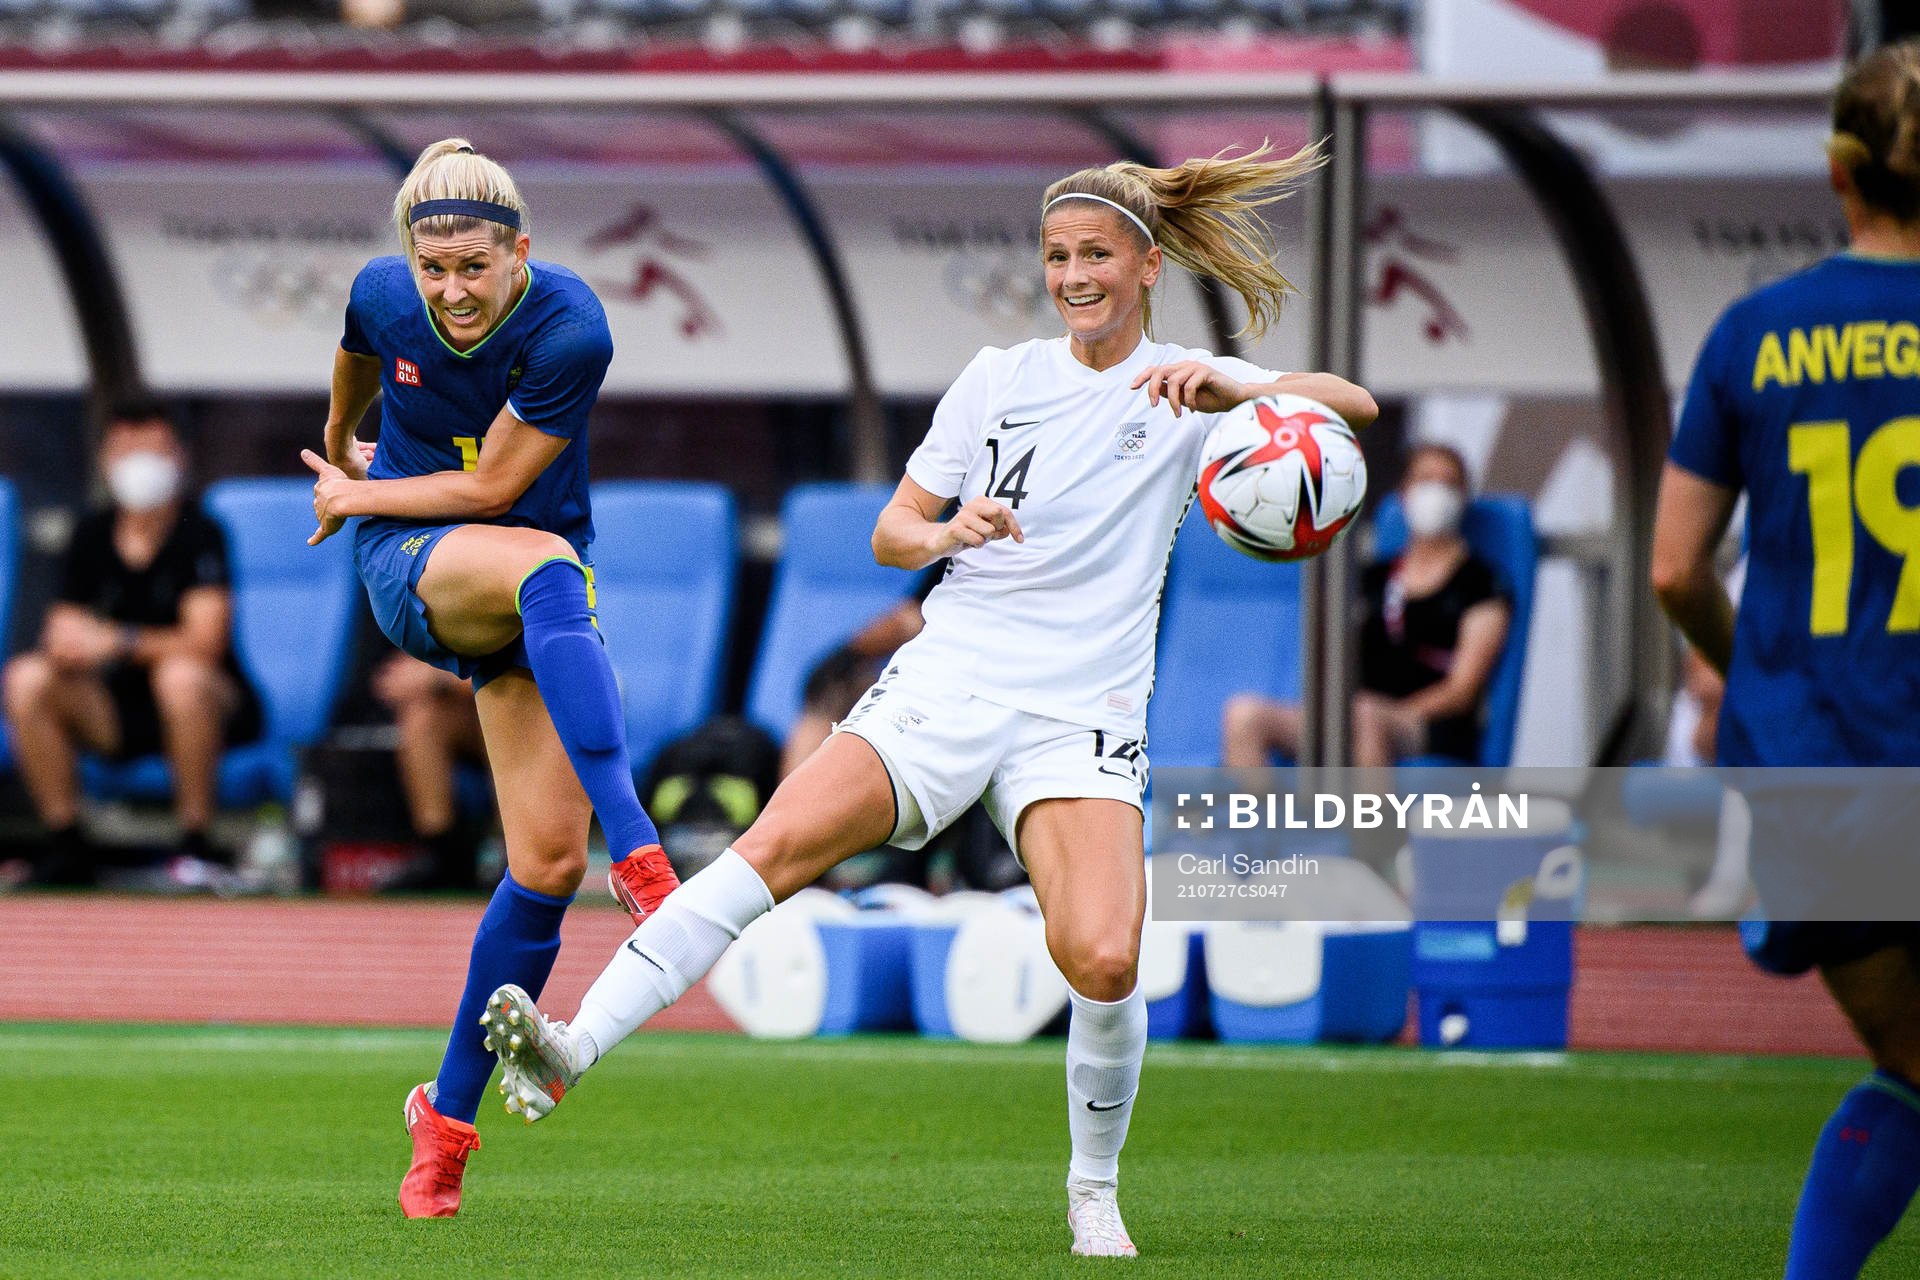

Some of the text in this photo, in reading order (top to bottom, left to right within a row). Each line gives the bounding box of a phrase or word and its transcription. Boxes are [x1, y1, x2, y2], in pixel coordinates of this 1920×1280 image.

[399, 361, 415, 374] UNI
[399, 371, 418, 384] QLO
[1752, 321, 1920, 392] ANVEG
[984, 438, 1038, 510] 14
[1788, 416, 1920, 637] 19
[1091, 729, 1140, 764] 14
